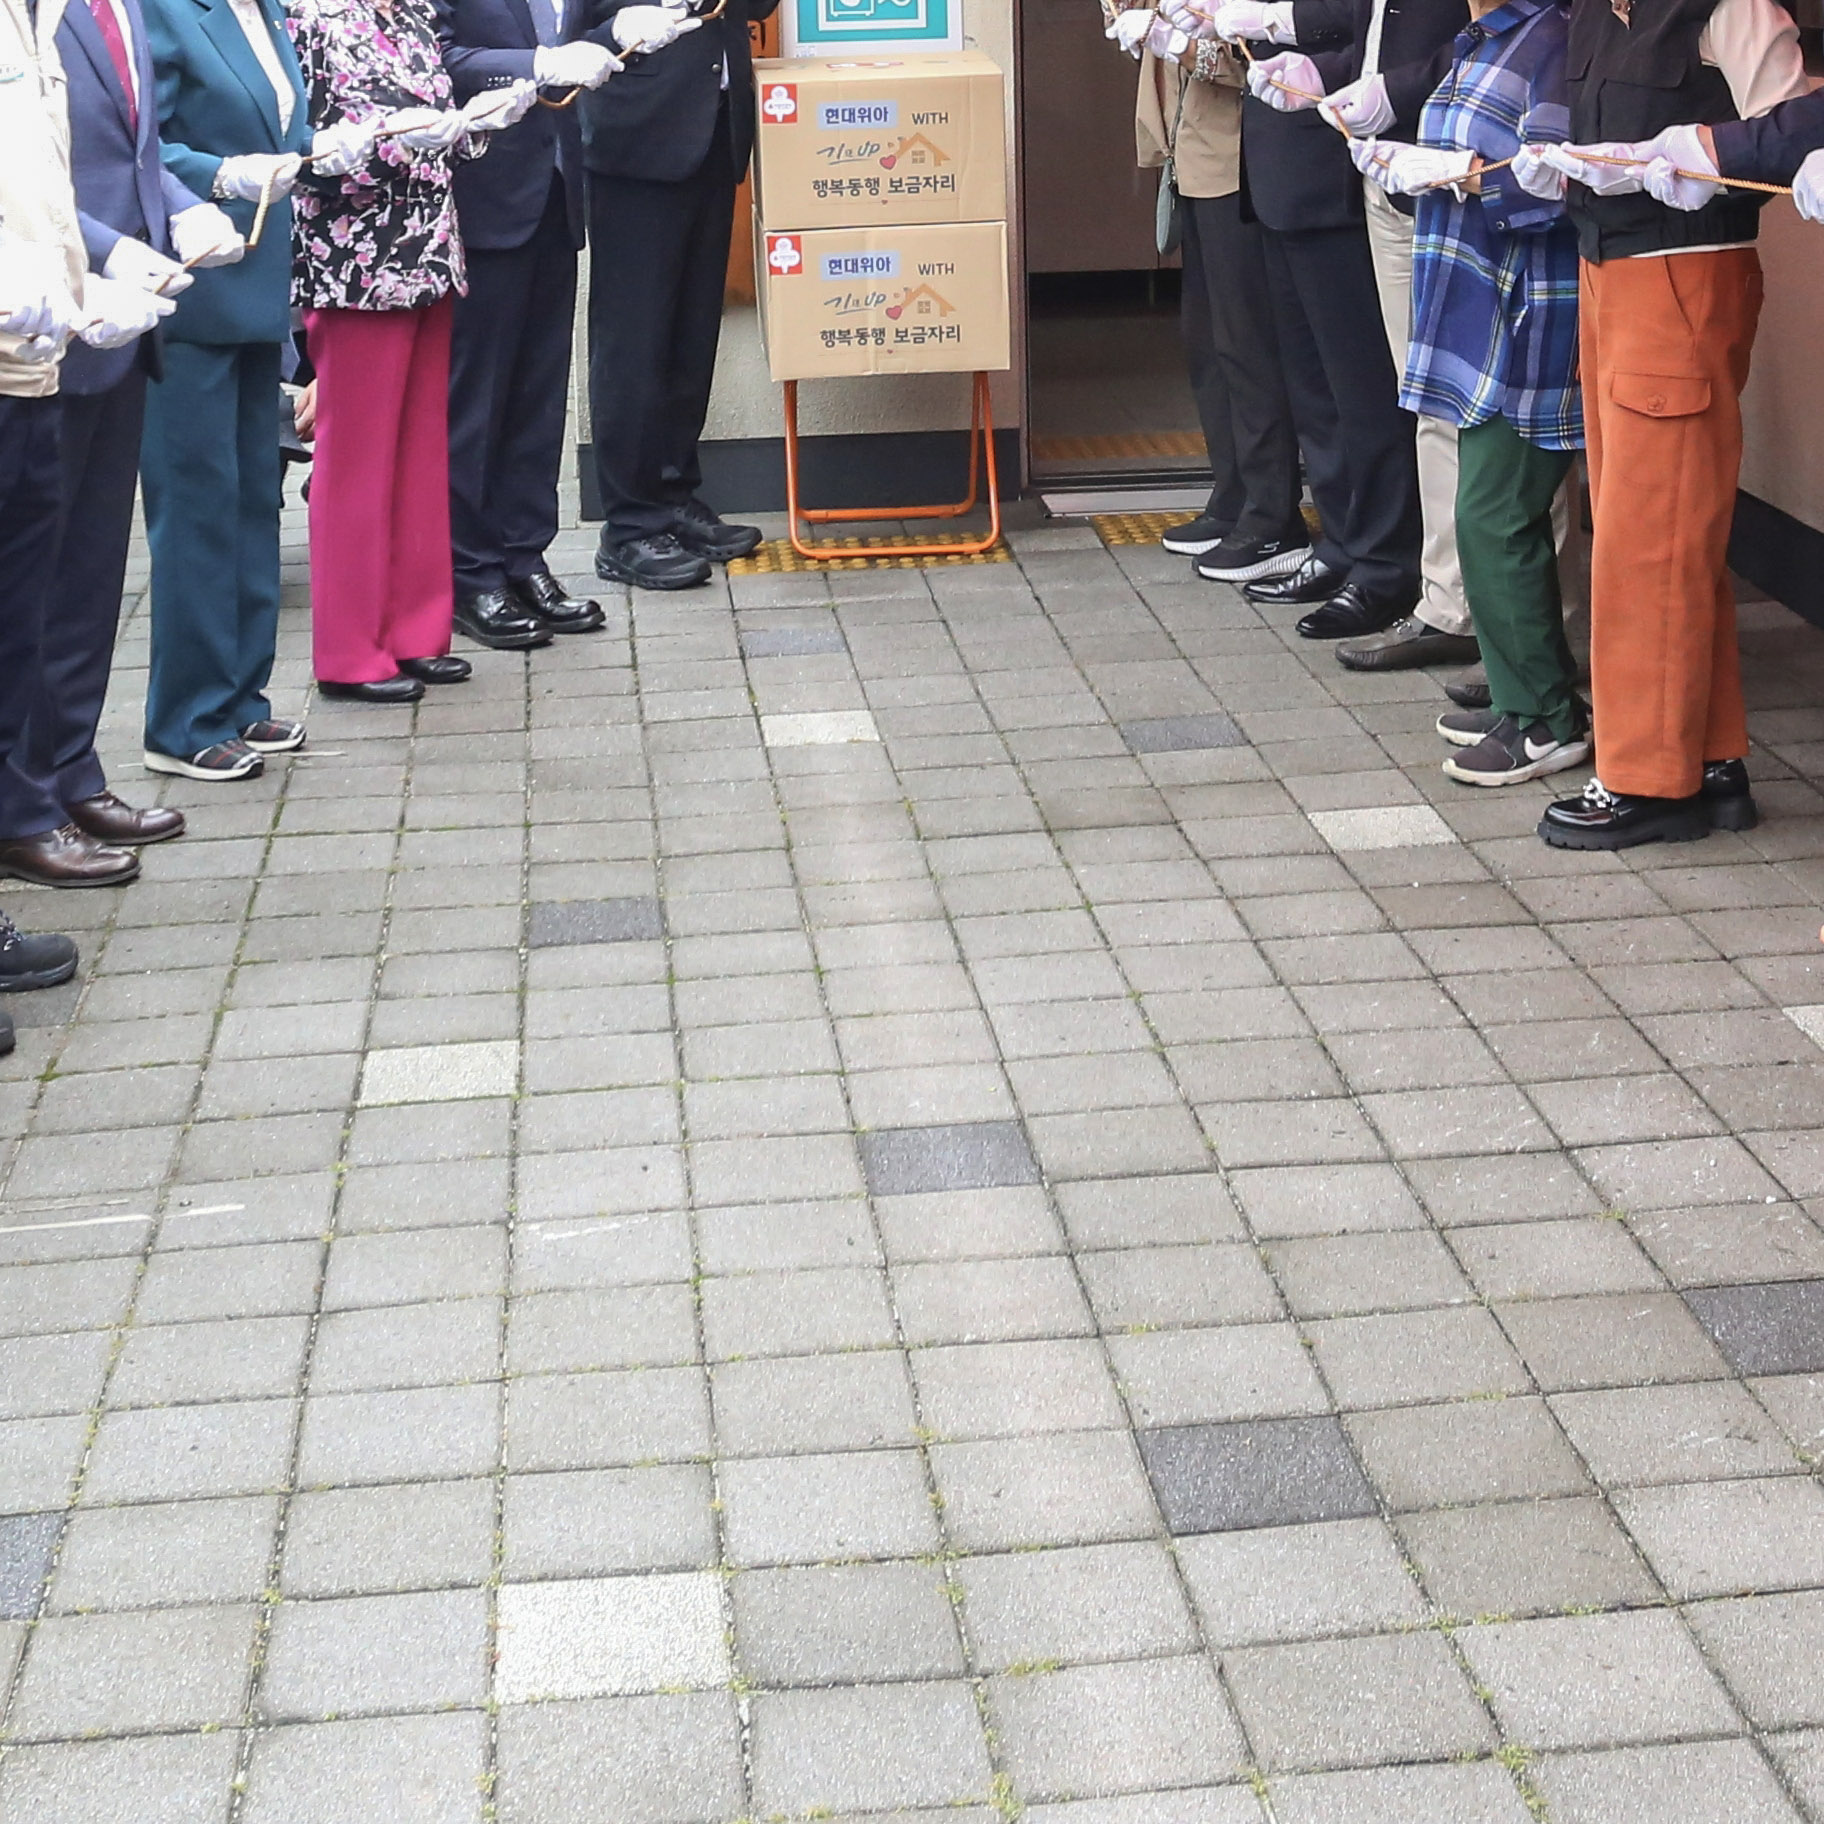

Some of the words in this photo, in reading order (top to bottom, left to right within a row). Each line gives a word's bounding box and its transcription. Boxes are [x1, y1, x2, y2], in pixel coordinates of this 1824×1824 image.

[825, 106, 888, 125] 현대위아
[912, 112, 949, 125] WITH
[812, 177, 880, 198] 행복동행
[887, 174, 956, 194] 보금자리
[828, 256, 891, 275] 현대위아
[918, 262, 955, 275] WITH
[820, 327, 886, 348] 행복동행
[893, 324, 961, 344] 보금자리
